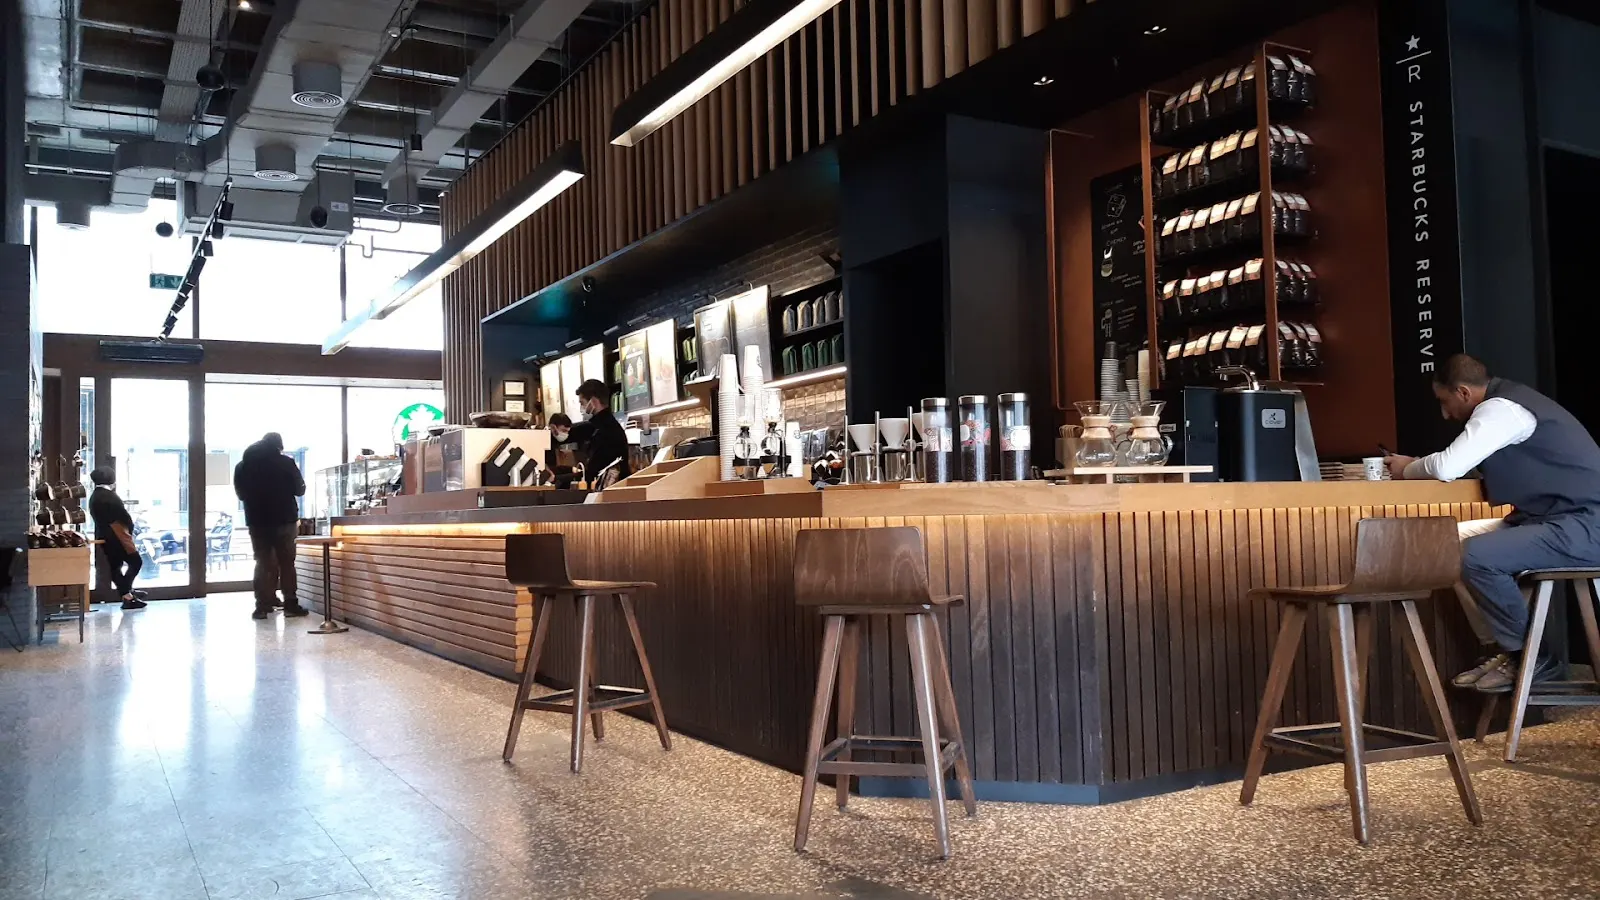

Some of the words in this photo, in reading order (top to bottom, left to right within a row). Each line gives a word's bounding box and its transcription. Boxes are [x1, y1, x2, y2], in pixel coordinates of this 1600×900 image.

[1407, 64, 1421, 83] R
[1409, 100, 1429, 242] STARBUCKS
[1416, 258, 1435, 373] RESERVE
